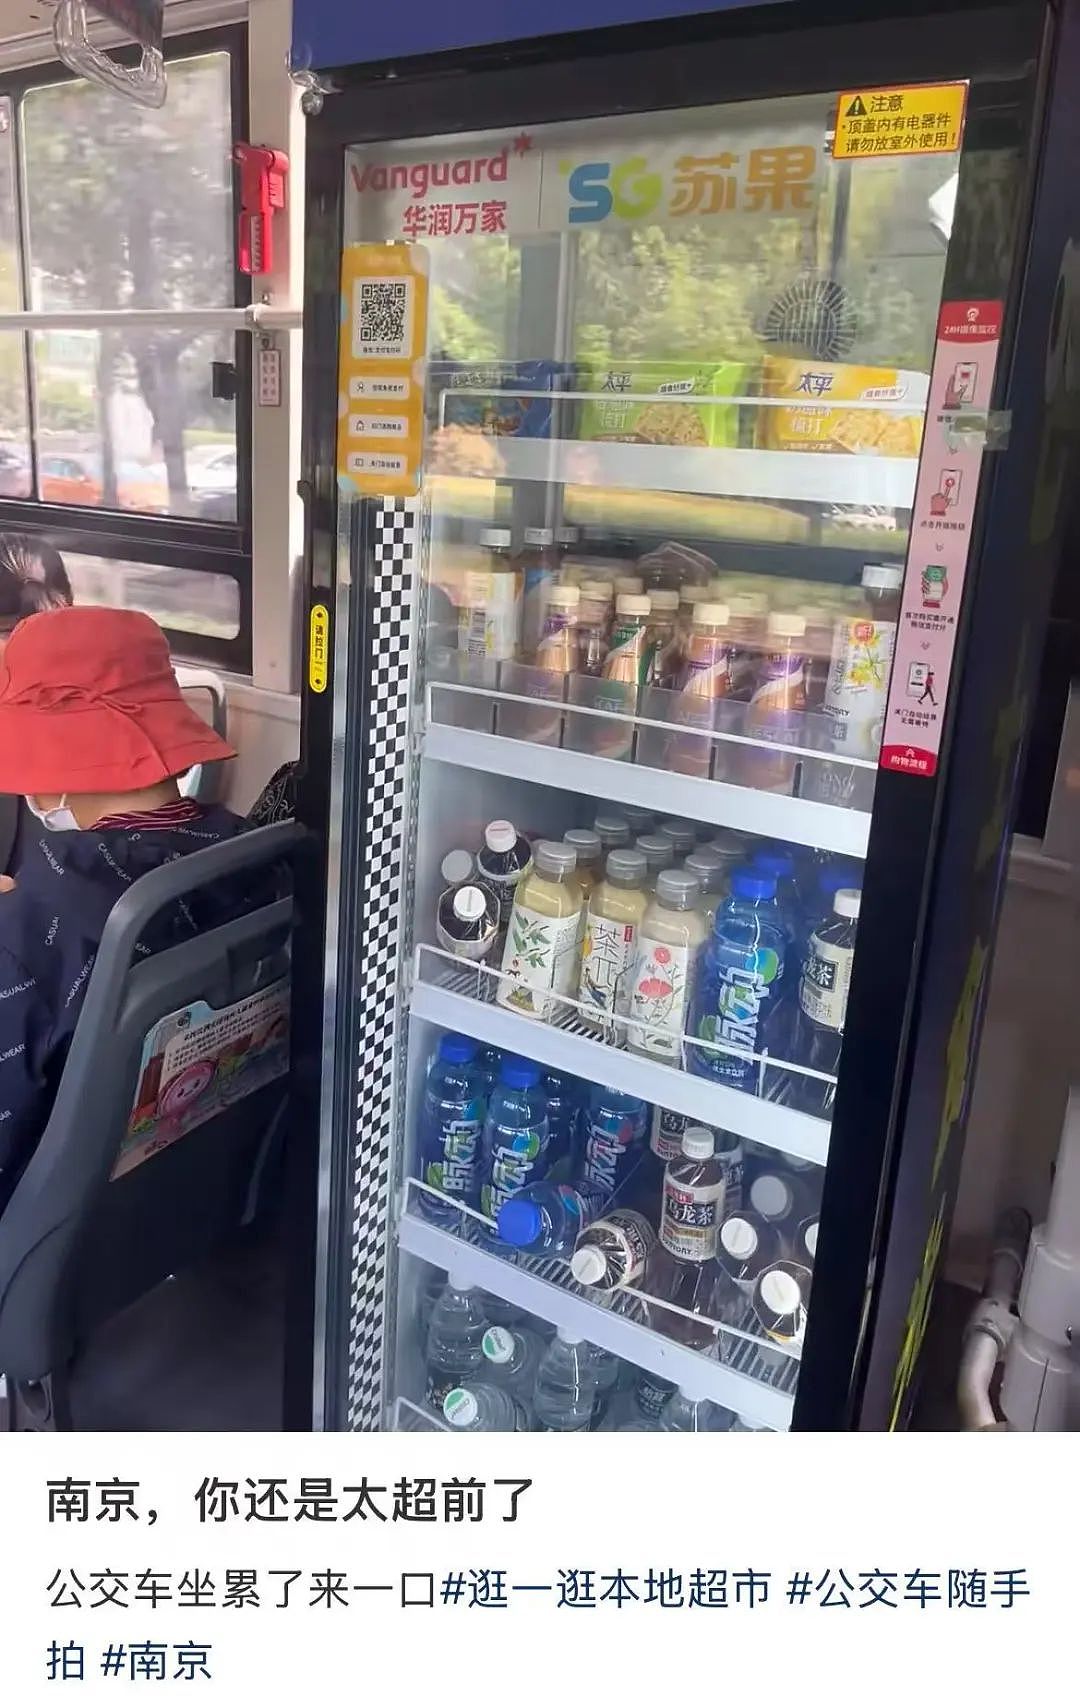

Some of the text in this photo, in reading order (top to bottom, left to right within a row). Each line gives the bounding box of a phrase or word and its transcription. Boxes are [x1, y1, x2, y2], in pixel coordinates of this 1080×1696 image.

[869, 94, 904, 113] 注意
[350, 150, 508, 198] Vanguard
[669, 145, 816, 218] 苏果
[402, 200, 508, 238] 华润万家
[601, 371, 632, 392] 太平
[796, 372, 834, 396] 太平
